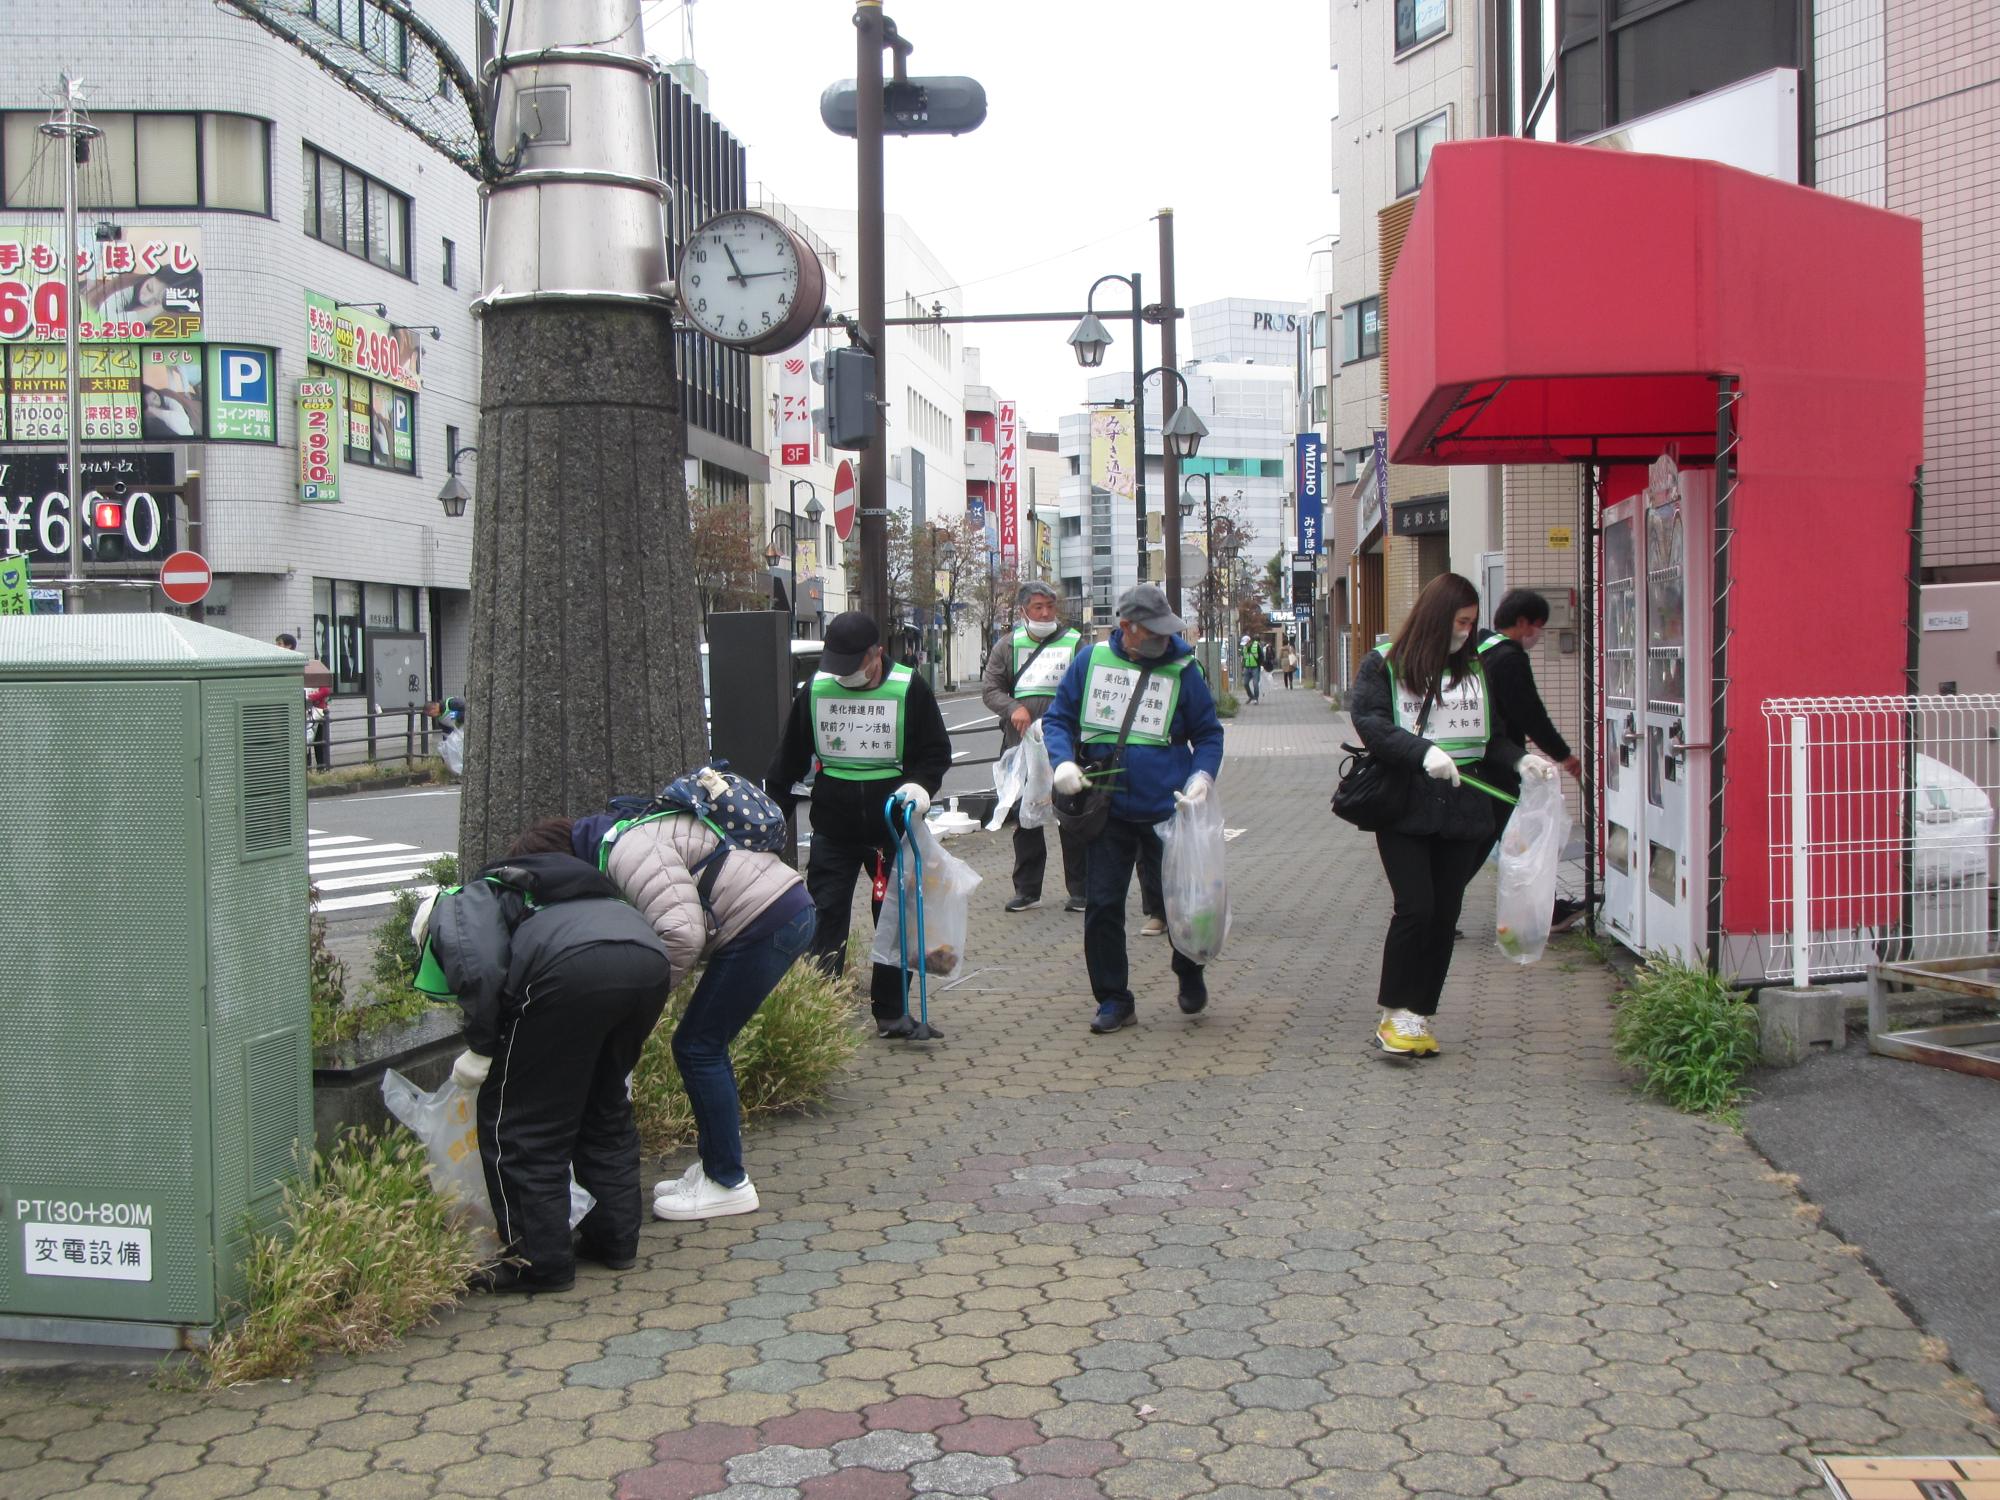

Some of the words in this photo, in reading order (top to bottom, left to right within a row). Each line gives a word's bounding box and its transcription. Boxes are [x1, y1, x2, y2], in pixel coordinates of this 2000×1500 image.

[697, 250, 707, 263] 10
[776, 242, 784, 257] 2
[691, 275, 701, 288] 9
[166, 288, 199, 299] 当ビル
[778, 293, 786, 304] 4
[698, 298, 707, 312] 8
[716, 314, 725, 327] 7
[761, 311, 771, 325] 5
[152, 317, 201, 338] 2F
[738, 319, 748, 332] 6
[310, 331, 335, 361] ほぐし
[355, 325, 399, 380] 2,960
[152, 351, 192, 363] ほぐし
[229, 356, 262, 397] P
[91, 379, 130, 391] 大和店
[301, 382, 333, 396] ほぐし
[396, 397, 407, 428] P
[1000, 404, 1015, 481] カラオケ
[787, 447, 805, 462] 3F
[1106, 415, 1122, 487] みずき通り
[58, 459, 134, 473] 平タイムサービス
[1305, 443, 1317, 496] MIZUHO
[306, 485, 316, 498] P
[1004, 484, 1014, 543] ドリンクバー
[830, 704, 885, 716] 美化推進月間
[1134, 714, 1161, 726] 和市
[1448, 719, 1481, 728] 大和市
[820, 721, 891, 734] 駅前クリーン活動
[859, 740, 893, 750] 大和市
[17, 1199, 152, 1225] PT(30+80)M
[35, 1237, 142, 1267] 変電設備
